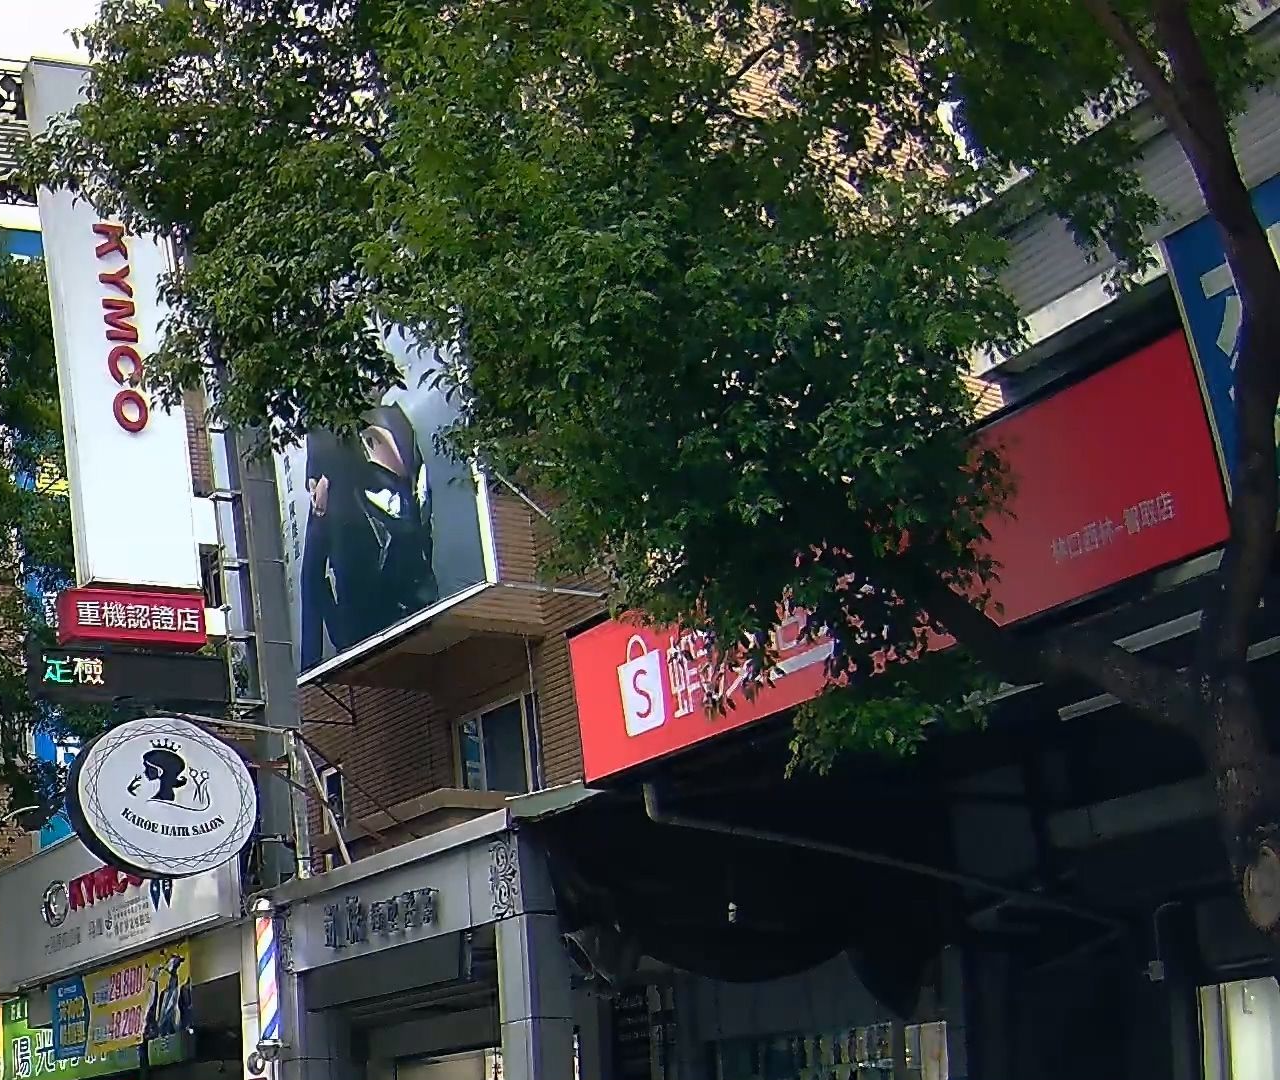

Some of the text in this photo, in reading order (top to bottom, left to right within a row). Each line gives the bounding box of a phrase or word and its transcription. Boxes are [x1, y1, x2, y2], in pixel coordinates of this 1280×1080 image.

[92, 223, 149, 433] KYMCO
[76, 600, 200, 633] 重機認證店
[42, 655, 105, 685] 定檢
[191, 814, 226, 837] SALON
